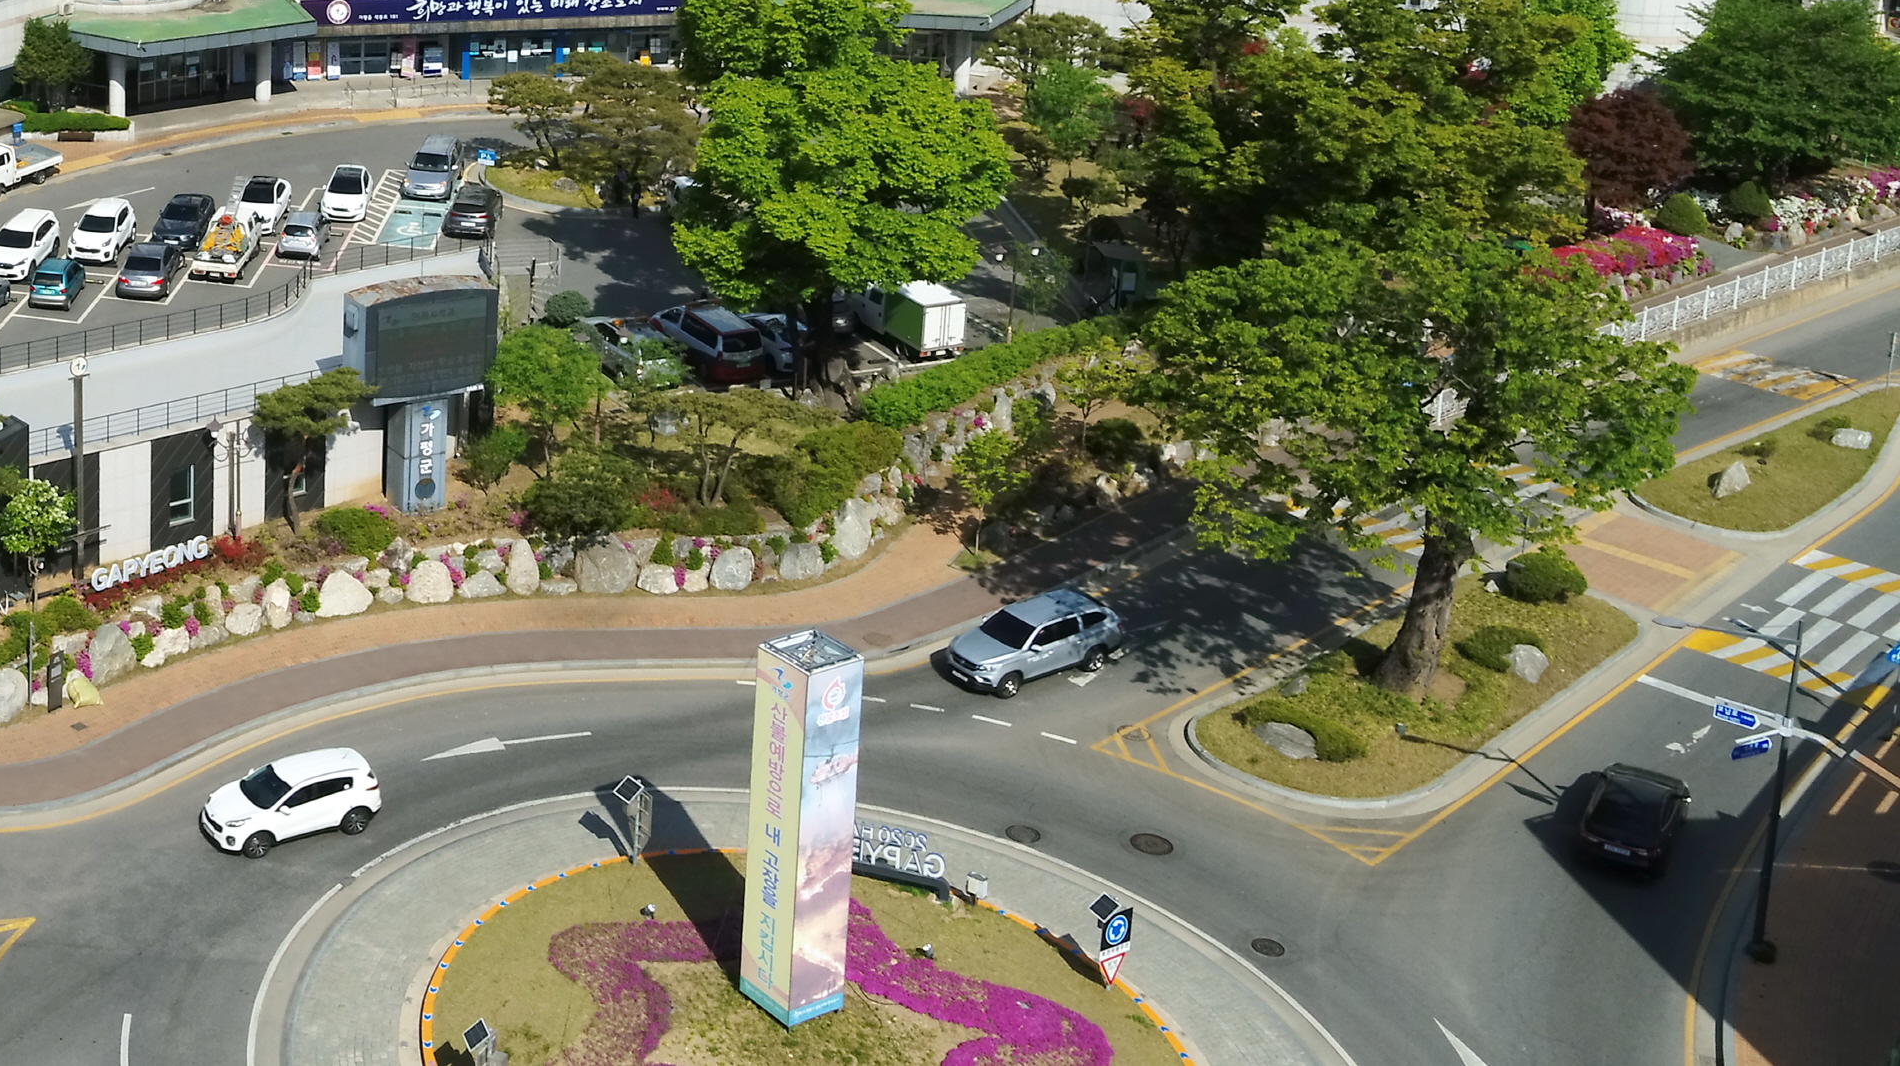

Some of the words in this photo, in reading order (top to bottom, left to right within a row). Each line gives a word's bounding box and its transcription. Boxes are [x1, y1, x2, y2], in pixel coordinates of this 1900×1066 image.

[419, 422, 435, 474] 가평군
[91, 535, 208, 592] GAPYEONG
[771, 685, 790, 702] 가평군
[765, 702, 788, 820] 산불예방으로
[765, 823, 781, 847] 내
[762, 848, 780, 910] 고장을
[757, 911, 776, 991] 지킵시다
